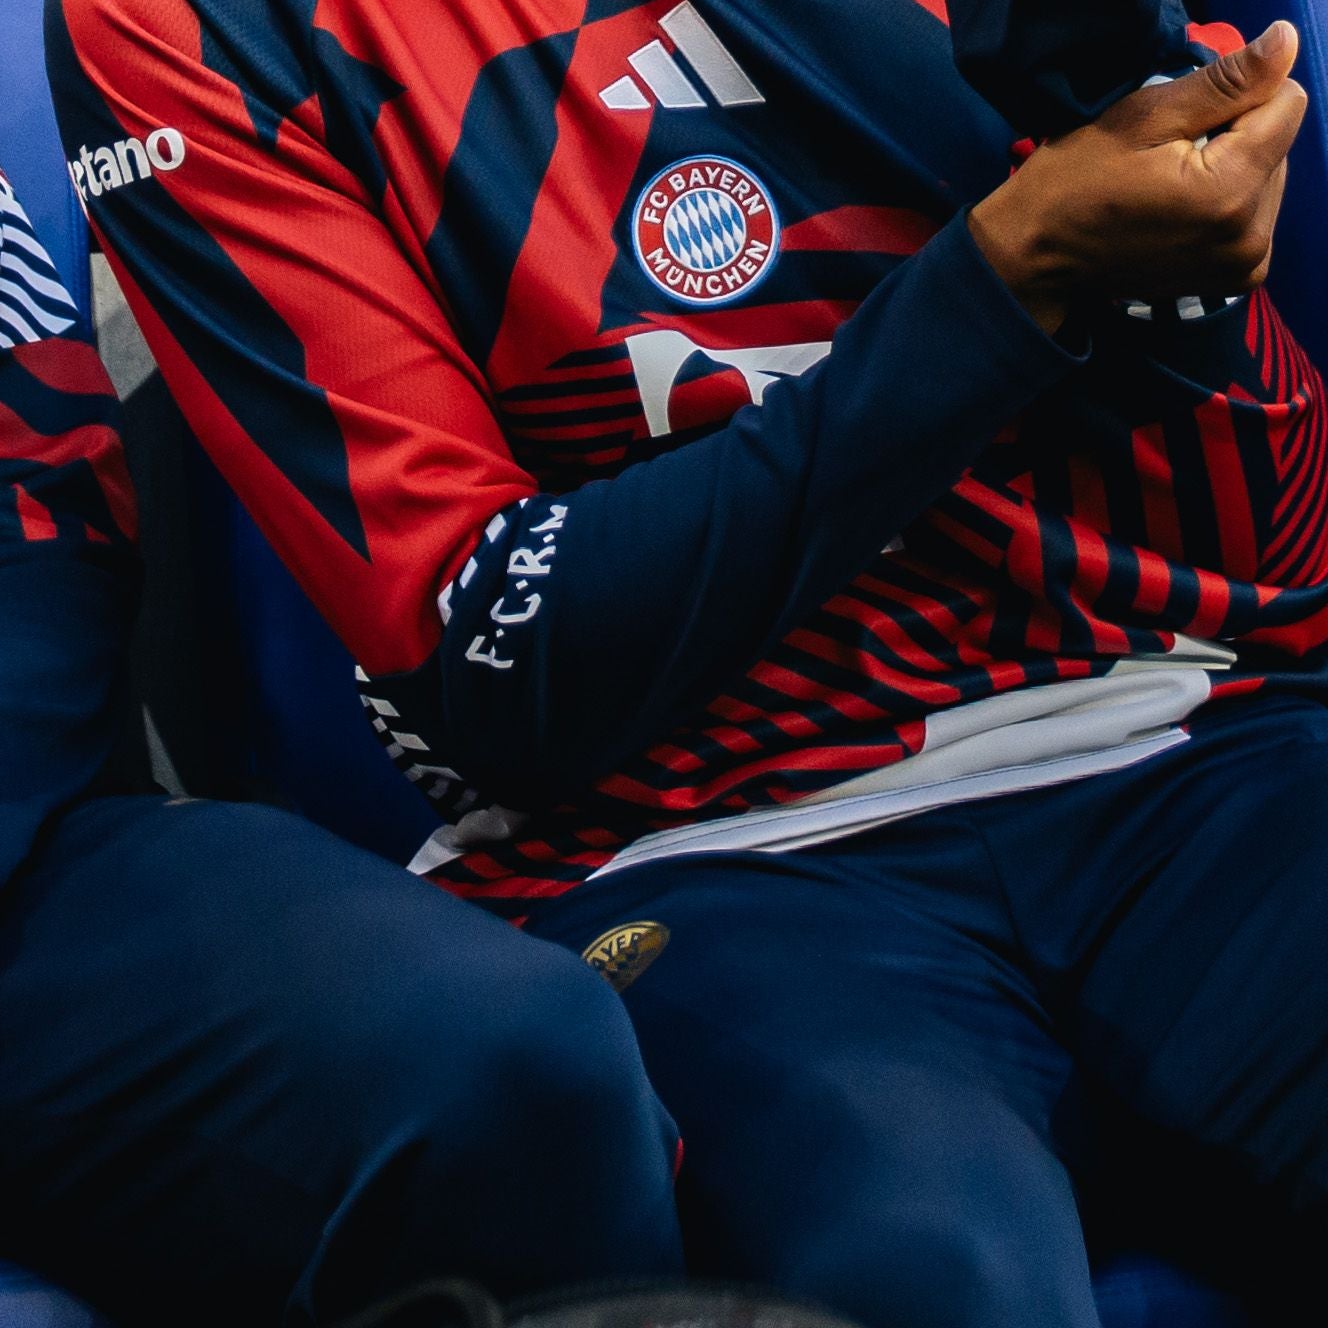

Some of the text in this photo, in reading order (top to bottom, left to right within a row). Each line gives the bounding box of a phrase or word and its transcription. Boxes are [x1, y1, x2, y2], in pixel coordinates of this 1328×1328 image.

[642, 166, 766, 225] FC BAYERN
[646, 238, 769, 296] MÜNCHEN
